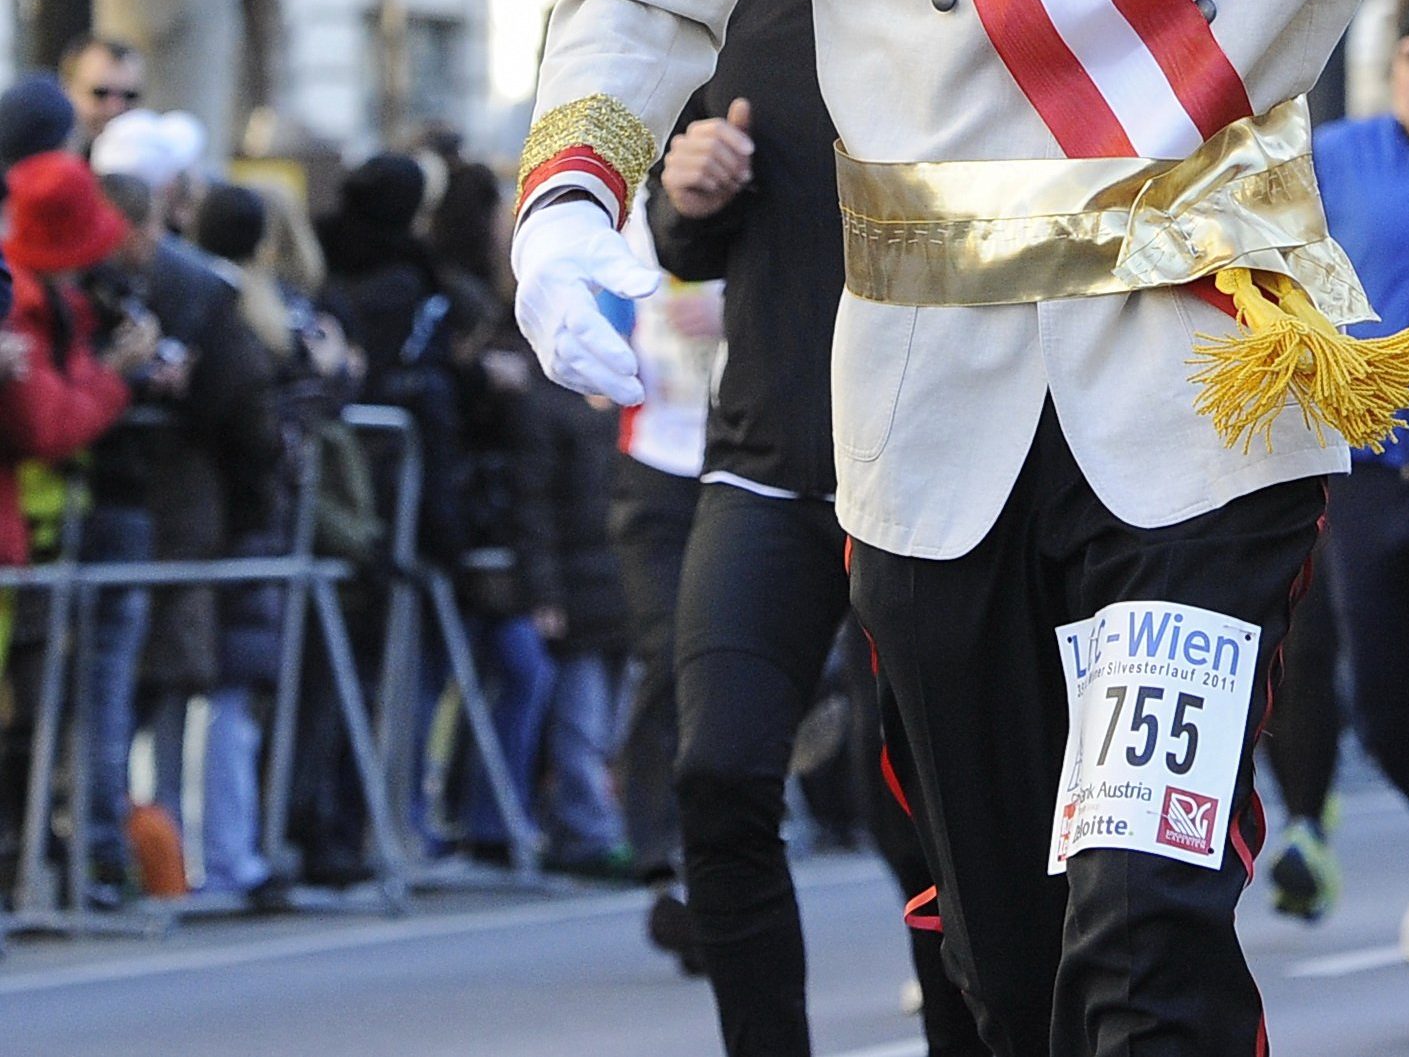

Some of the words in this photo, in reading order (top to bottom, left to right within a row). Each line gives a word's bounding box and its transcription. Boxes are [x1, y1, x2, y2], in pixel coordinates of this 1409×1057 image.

[1106, 661, 1196, 682] Silvesterlauf
[1202, 671, 1236, 693] 2011
[1096, 685, 1205, 775] 755
[1097, 780, 1152, 802] Austria
